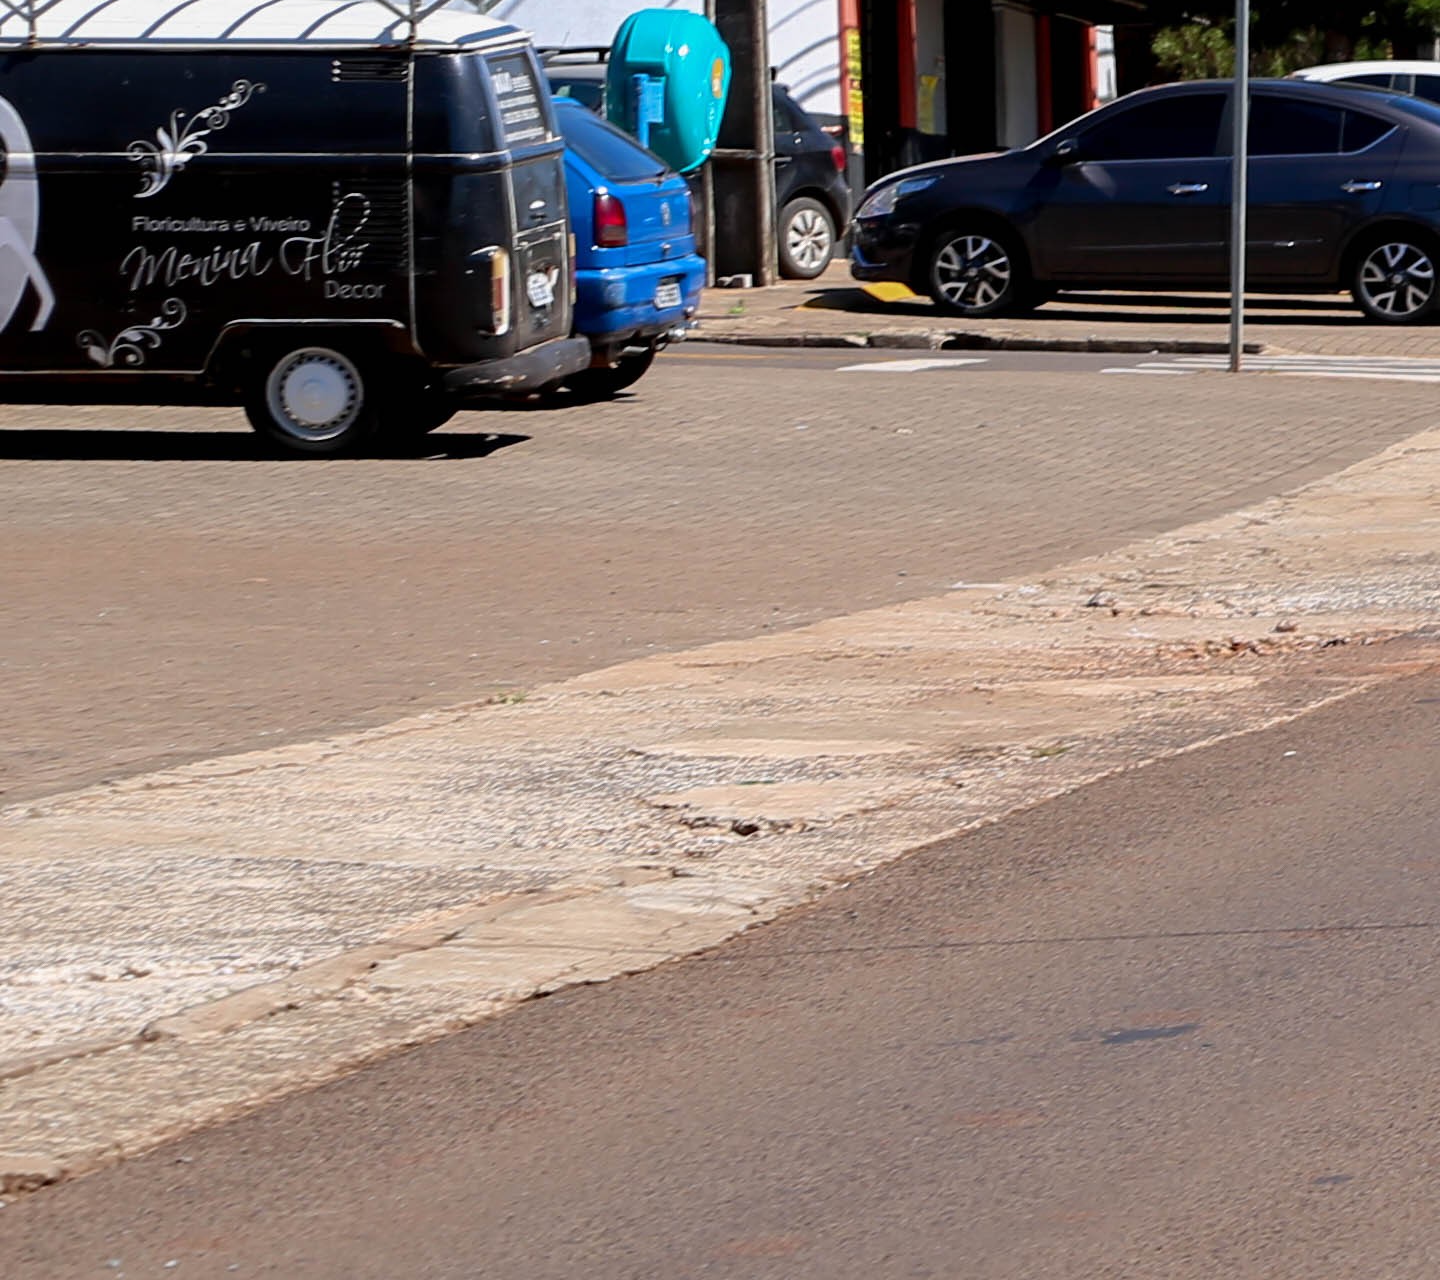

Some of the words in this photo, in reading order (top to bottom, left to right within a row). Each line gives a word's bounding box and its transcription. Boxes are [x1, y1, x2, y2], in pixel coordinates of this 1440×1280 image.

[132, 216, 228, 232] Floricultura
[233, 220, 246, 232] e
[250, 216, 311, 232] Viveiro
[119, 241, 273, 291] Menina
[324, 280, 386, 299] Decor
